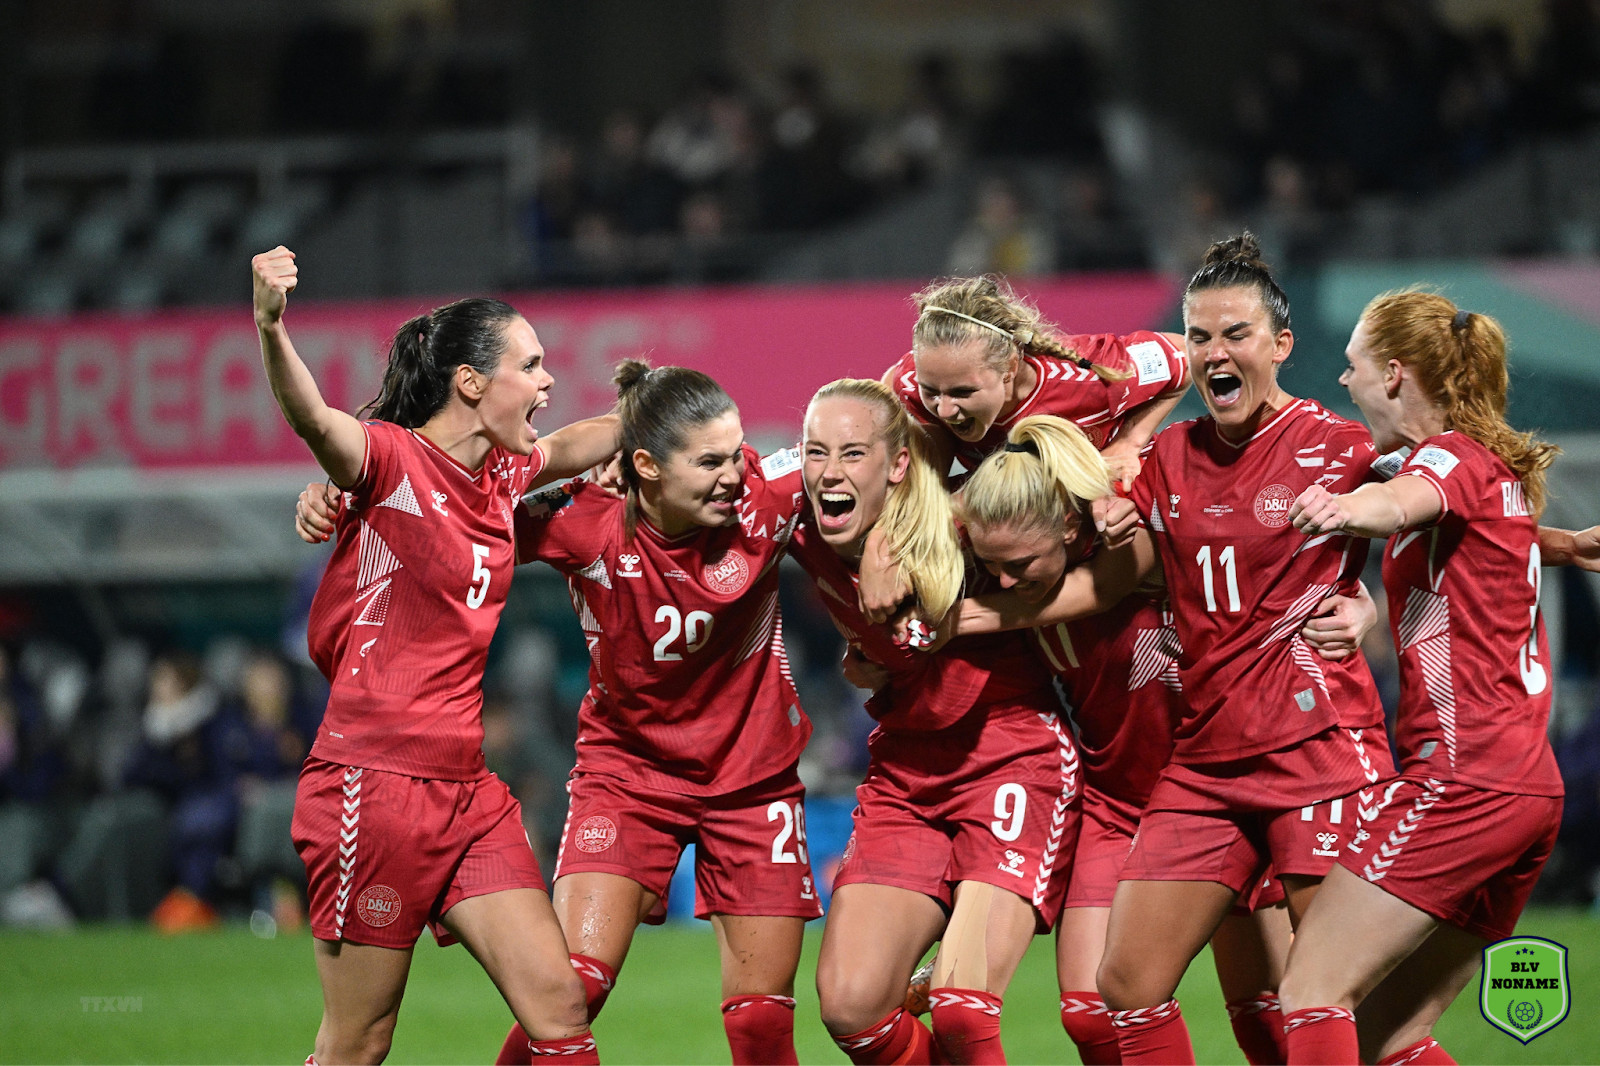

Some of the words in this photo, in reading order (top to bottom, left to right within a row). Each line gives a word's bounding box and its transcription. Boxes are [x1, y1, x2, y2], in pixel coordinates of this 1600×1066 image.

[1264, 499, 1288, 511] DBU
[466, 543, 491, 610] 5
[713, 560, 740, 582] DBU
[1196, 546, 1241, 612] 11
[653, 604, 714, 662] 20
[991, 783, 1027, 842] 9
[583, 828, 607, 840] DBU
[366, 898, 392, 912] DBU
